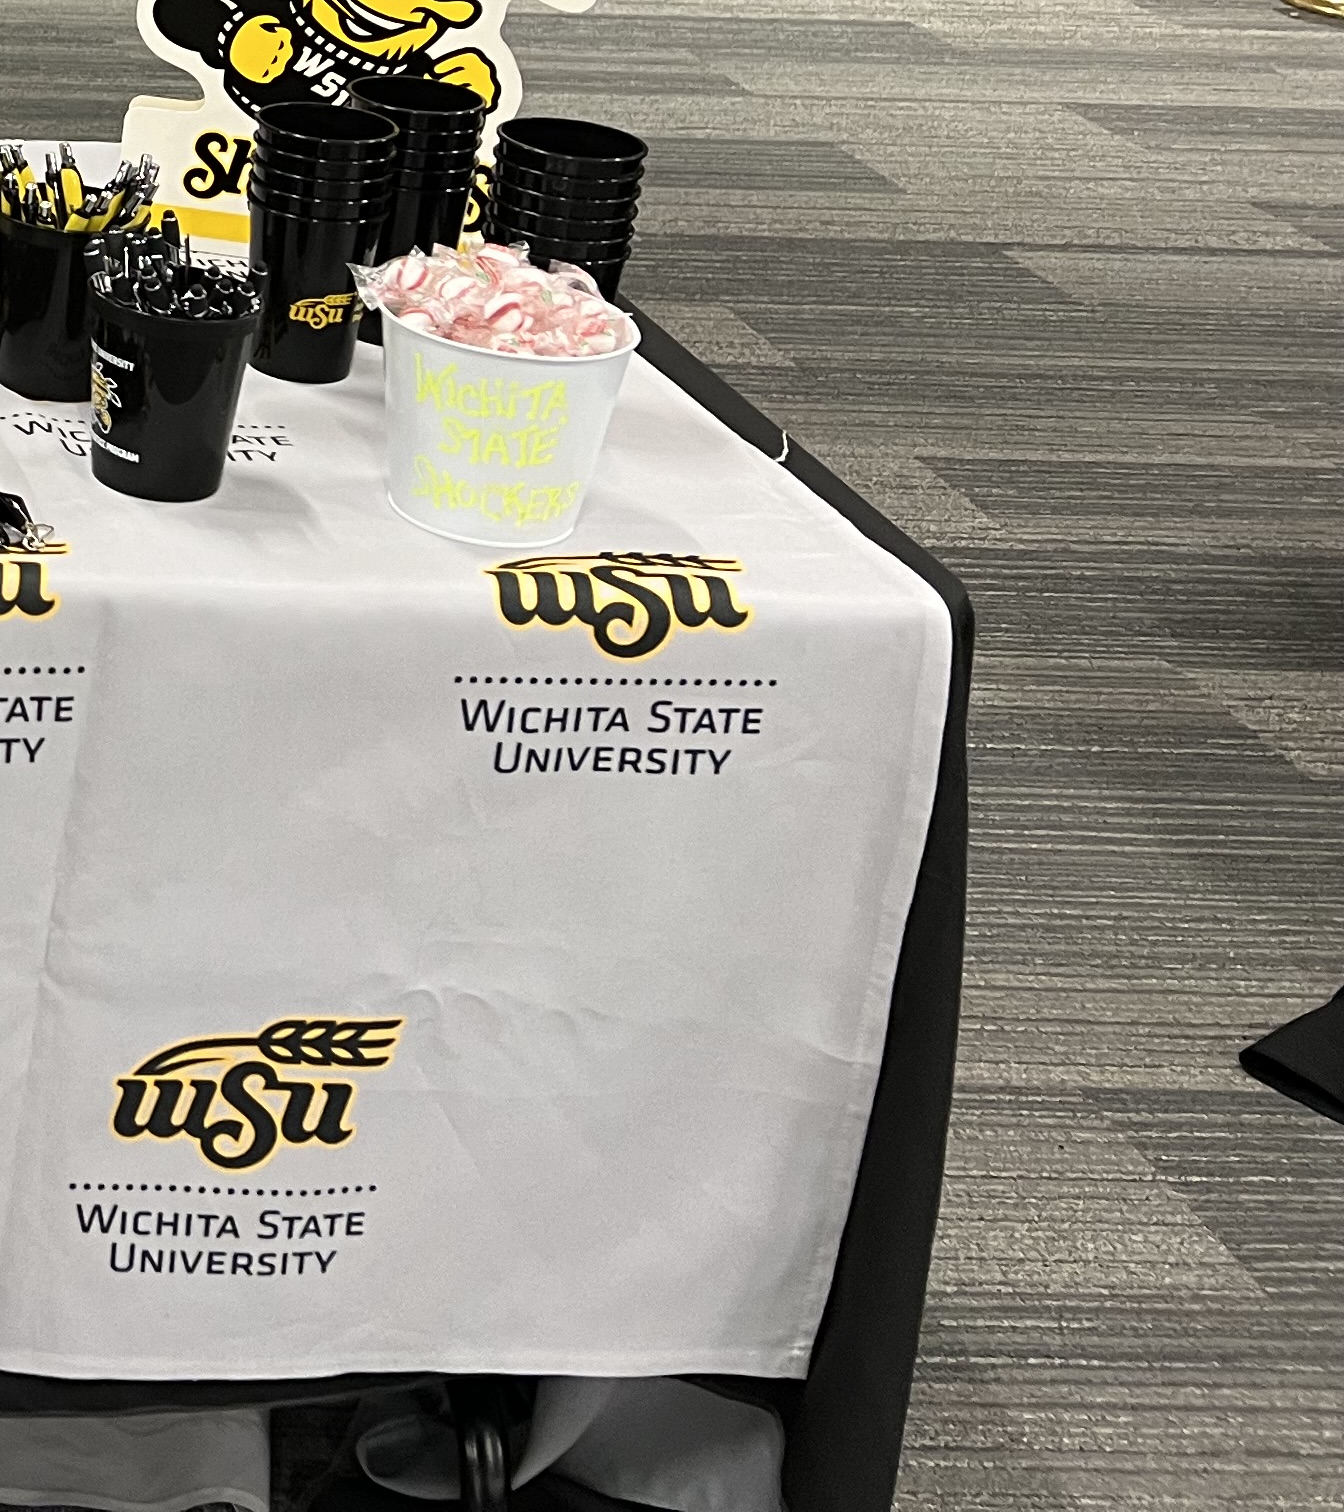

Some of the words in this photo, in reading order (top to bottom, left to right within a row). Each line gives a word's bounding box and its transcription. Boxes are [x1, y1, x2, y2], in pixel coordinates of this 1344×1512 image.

[460, 698, 631, 734] WICHITA
[647, 700, 764, 735] STATE
[493, 742, 732, 776] UNIVERSITY
[76, 1203, 240, 1238] WICHITA
[257, 1209, 366, 1240] STATE
[111, 1242, 338, 1276] UNIVERSITY
